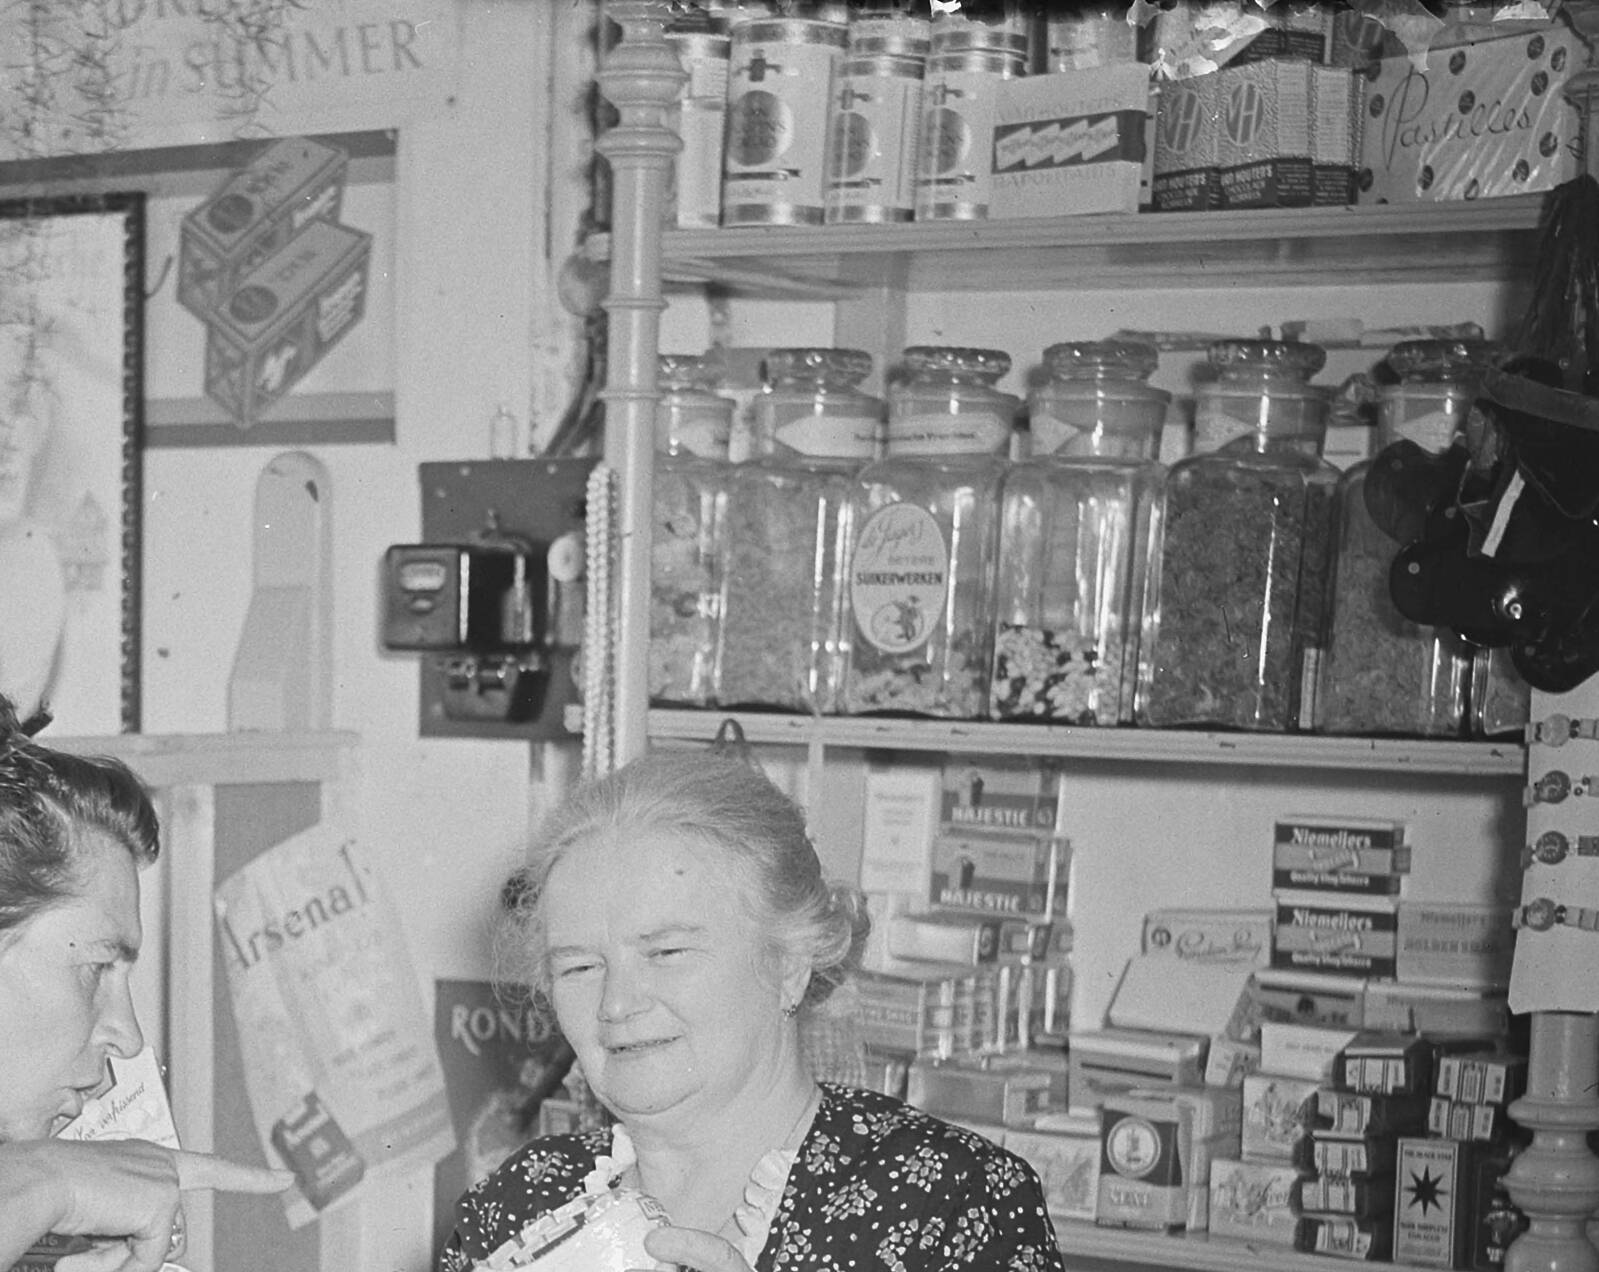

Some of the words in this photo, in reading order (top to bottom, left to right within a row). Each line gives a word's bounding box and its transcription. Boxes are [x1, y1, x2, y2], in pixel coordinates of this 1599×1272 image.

[183, 19, 424, 96] SUMMER
[1383, 64, 1532, 172] Pastilles
[951, 806, 1027, 827] MAJESTIC
[940, 888, 1020, 912] MAJESTIC
[450, 1003, 559, 1056] ROND
